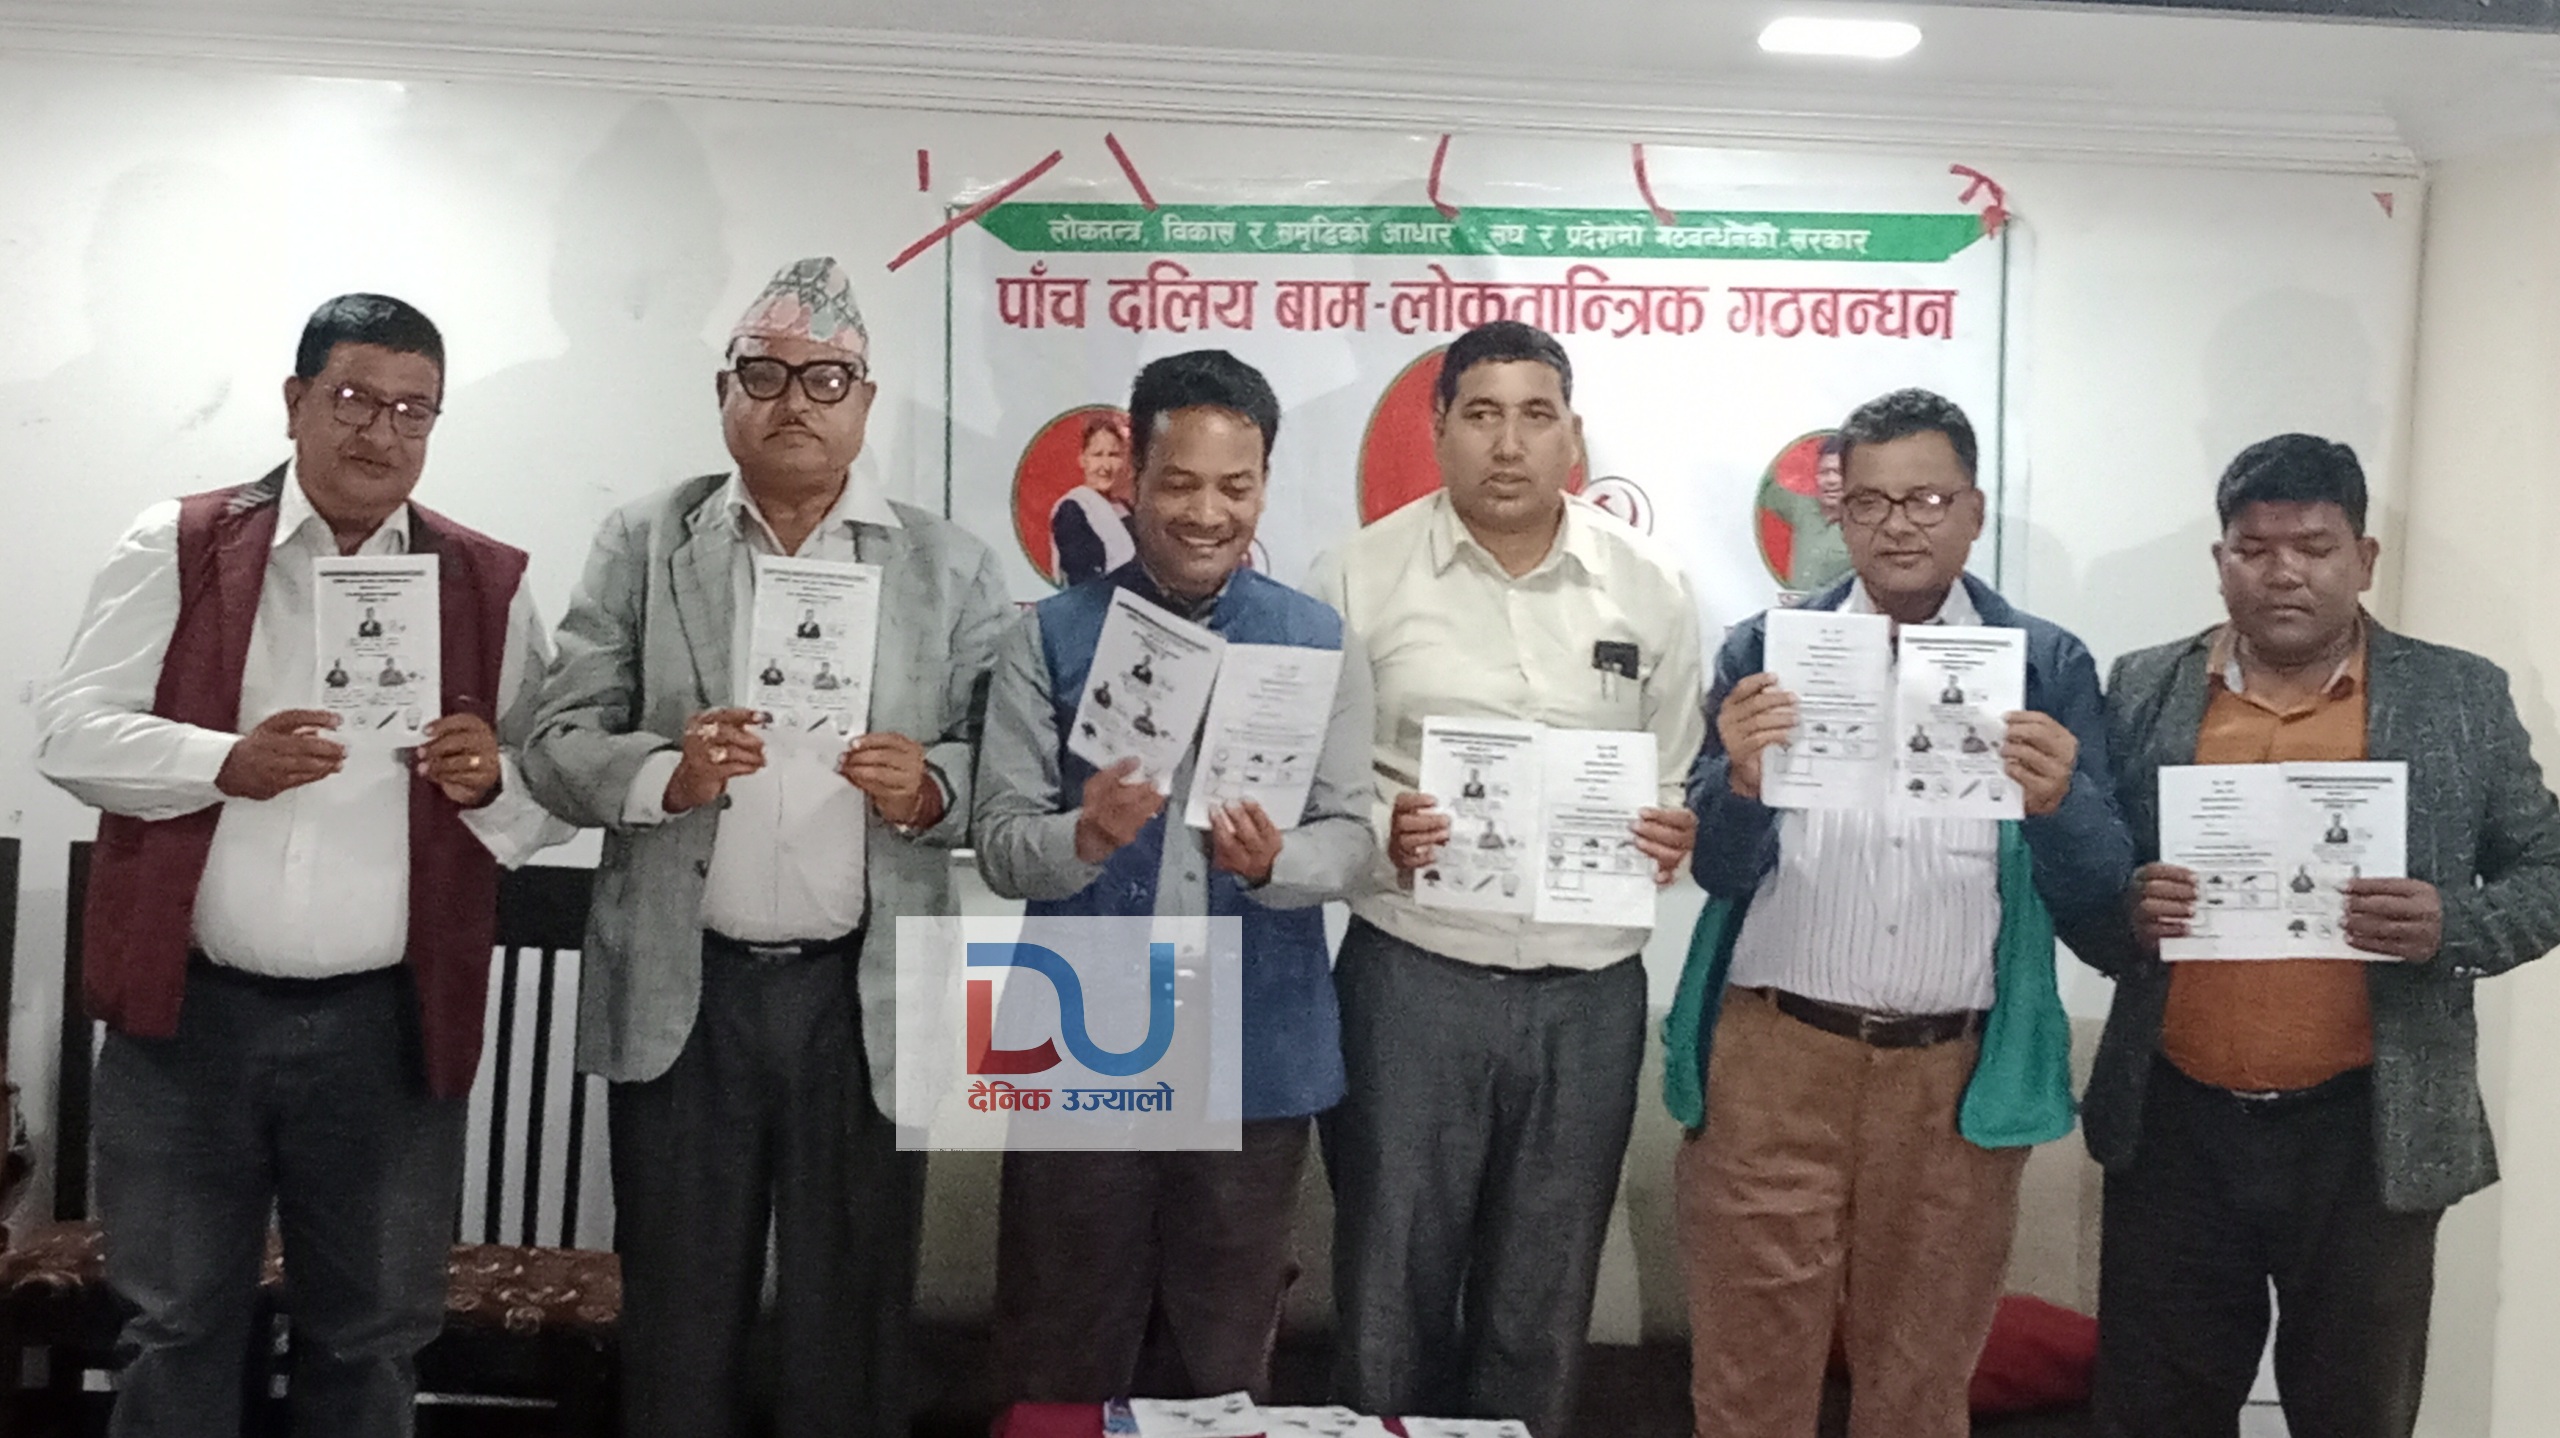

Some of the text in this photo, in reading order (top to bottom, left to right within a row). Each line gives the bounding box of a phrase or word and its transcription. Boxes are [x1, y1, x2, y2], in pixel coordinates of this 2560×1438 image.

[1161, 213, 1237, 245] विकास
[1247, 221, 1267, 248] र
[1536, 225, 1556, 251] र
[1787, 228, 1871, 254] सरकार
[996, 259, 1090, 331] पाँच
[1107, 259, 1258, 334] दलिय
[1727, 286, 1959, 341] गठबन्धन
